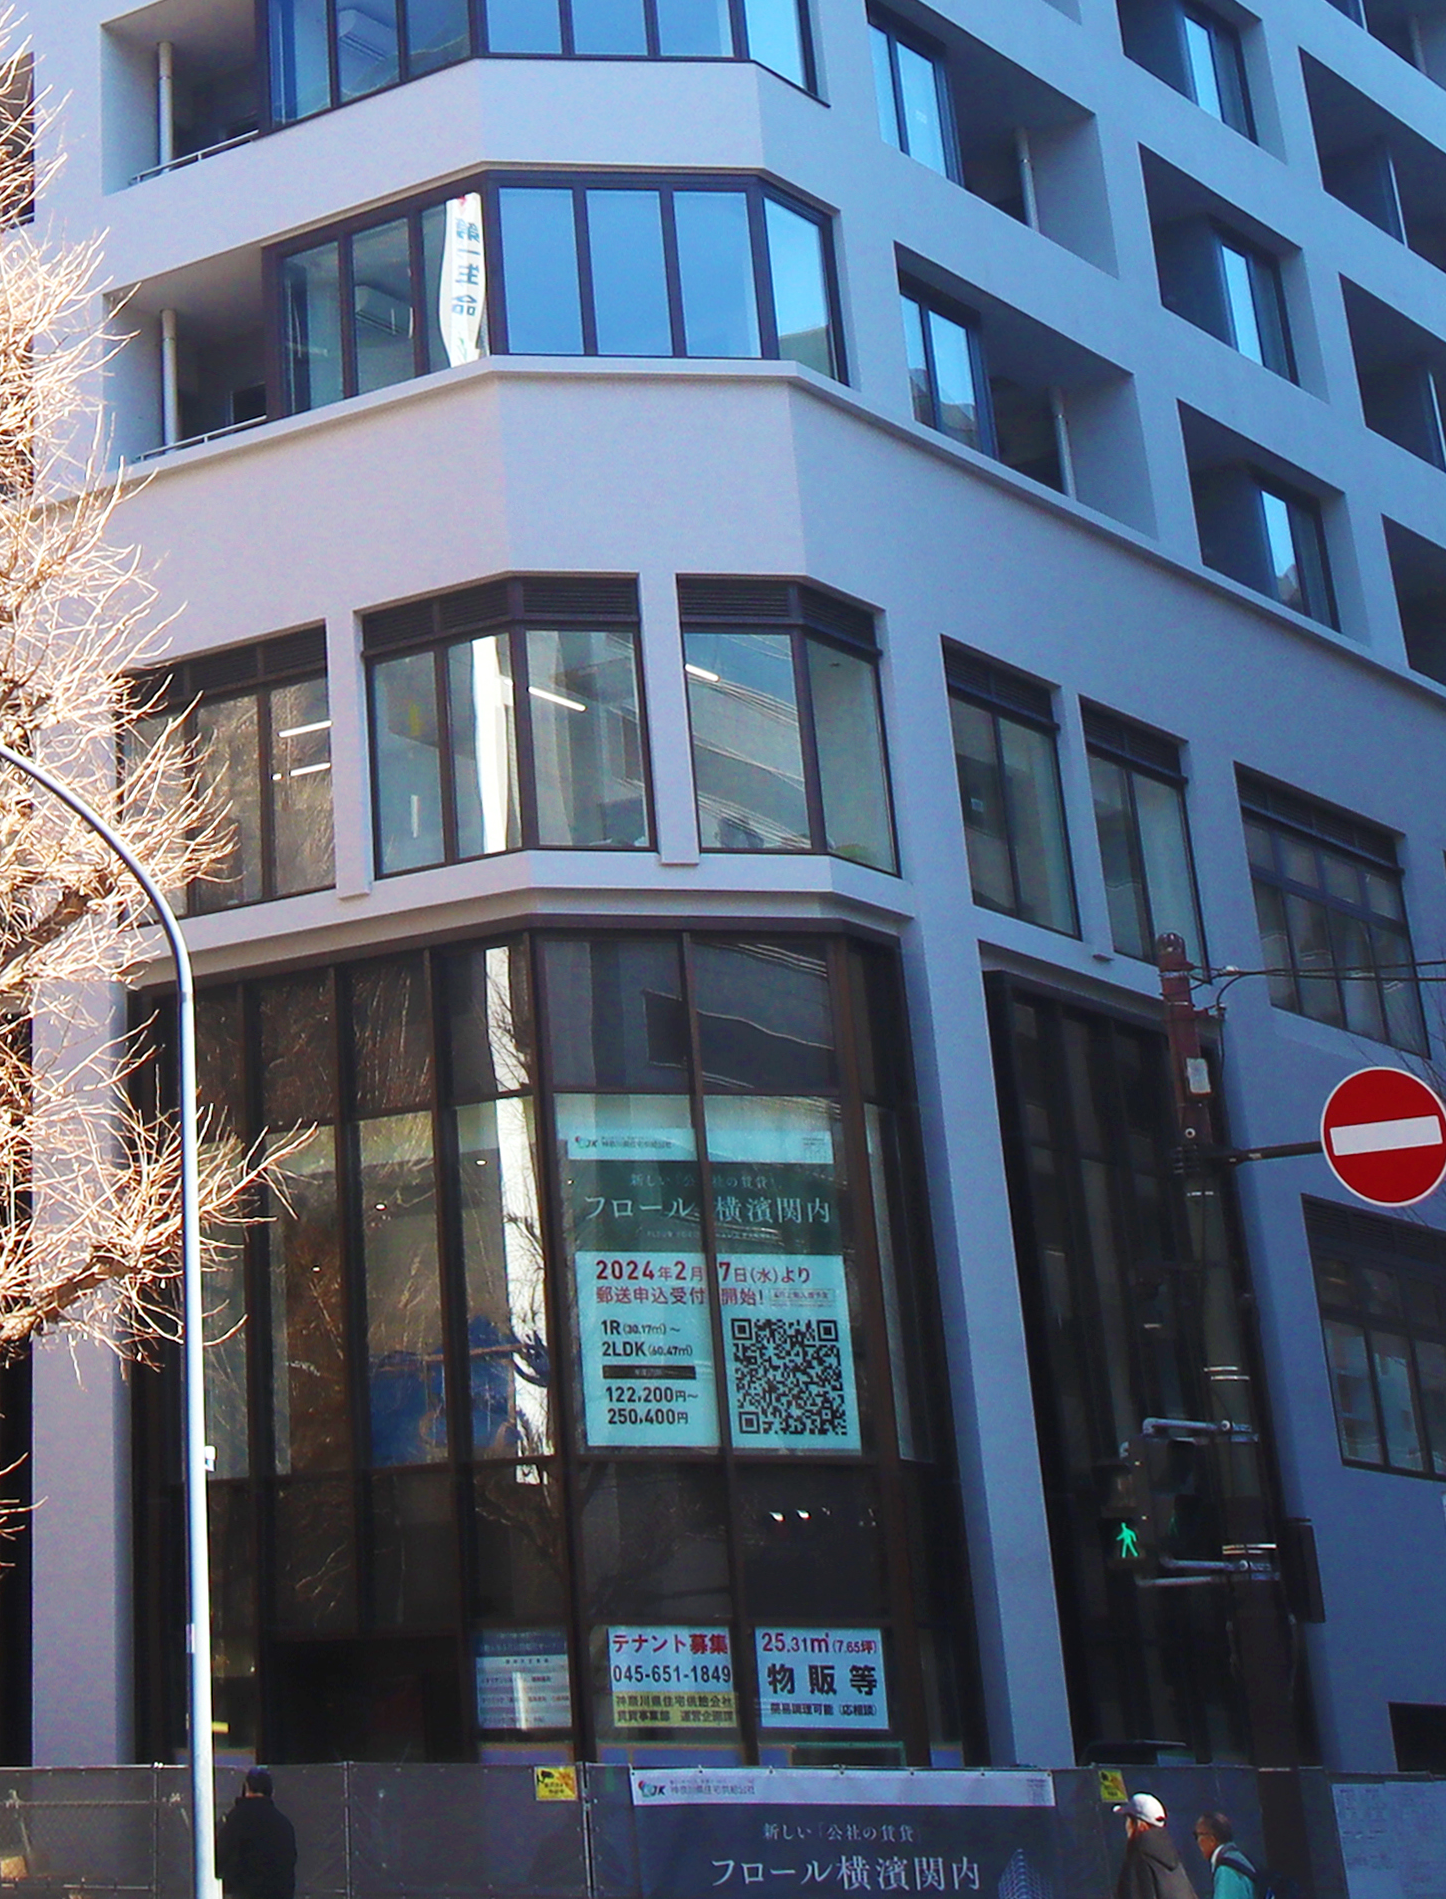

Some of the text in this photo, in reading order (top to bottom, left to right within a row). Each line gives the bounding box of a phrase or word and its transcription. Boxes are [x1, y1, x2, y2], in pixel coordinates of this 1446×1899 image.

[607, 1408, 689, 1425] 250,400円
[612, 1632, 730, 1655] テナント募集
[612, 1664, 732, 1684] 045-651-1849
[711, 1855, 982, 1892] フロール横濱関内
